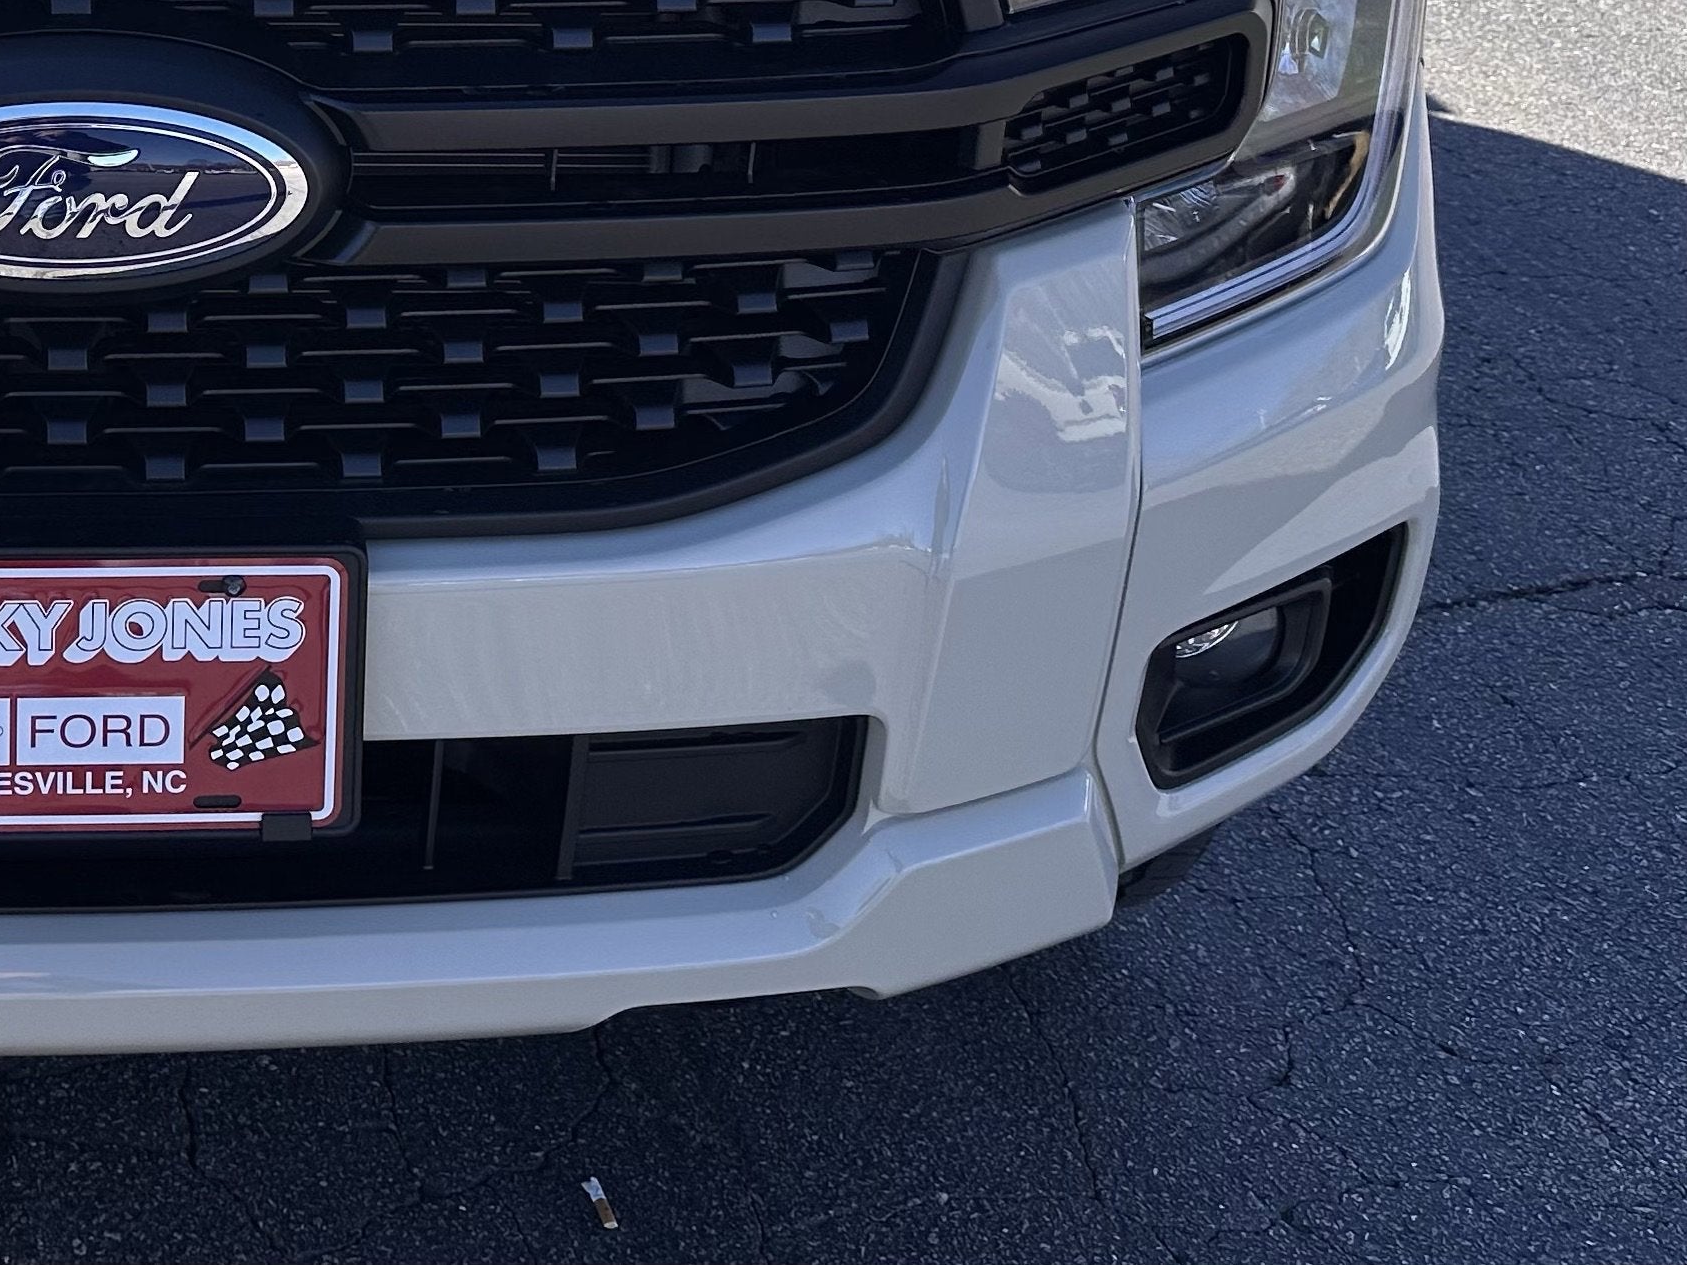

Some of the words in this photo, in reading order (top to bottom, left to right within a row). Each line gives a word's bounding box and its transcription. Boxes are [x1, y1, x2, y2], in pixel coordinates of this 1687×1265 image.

[63, 597, 307, 664] JONES
[30, 714, 171, 749] FORD
[142, 770, 188, 795] NC
